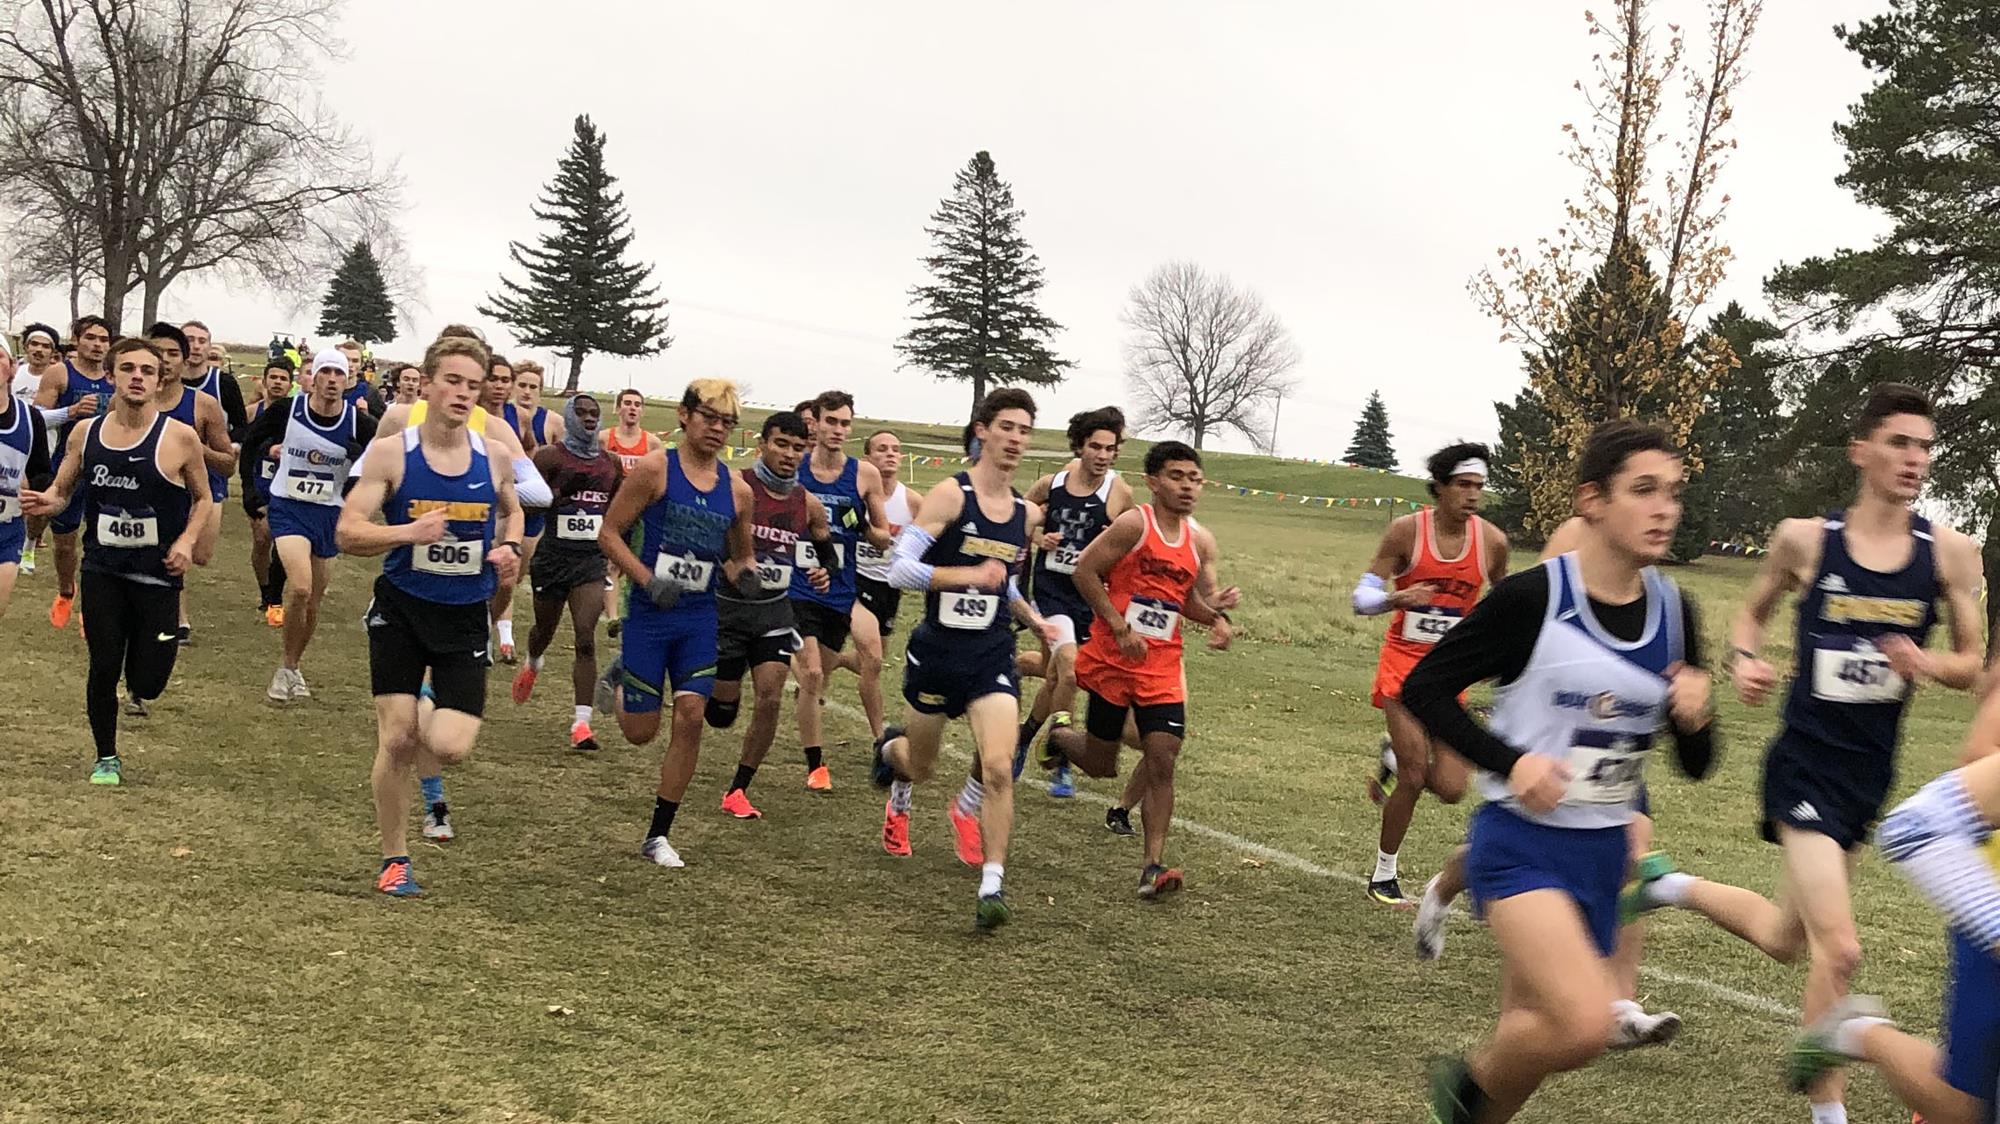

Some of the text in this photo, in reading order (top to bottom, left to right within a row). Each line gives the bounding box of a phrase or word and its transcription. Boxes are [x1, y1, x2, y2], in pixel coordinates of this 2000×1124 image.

[91, 464, 140, 490] Bears
[296, 480, 325, 495] 477
[108, 520, 146, 538] 468
[567, 518, 595, 531] 684
[427, 543, 471, 565] 606
[668, 561, 703, 582] 420
